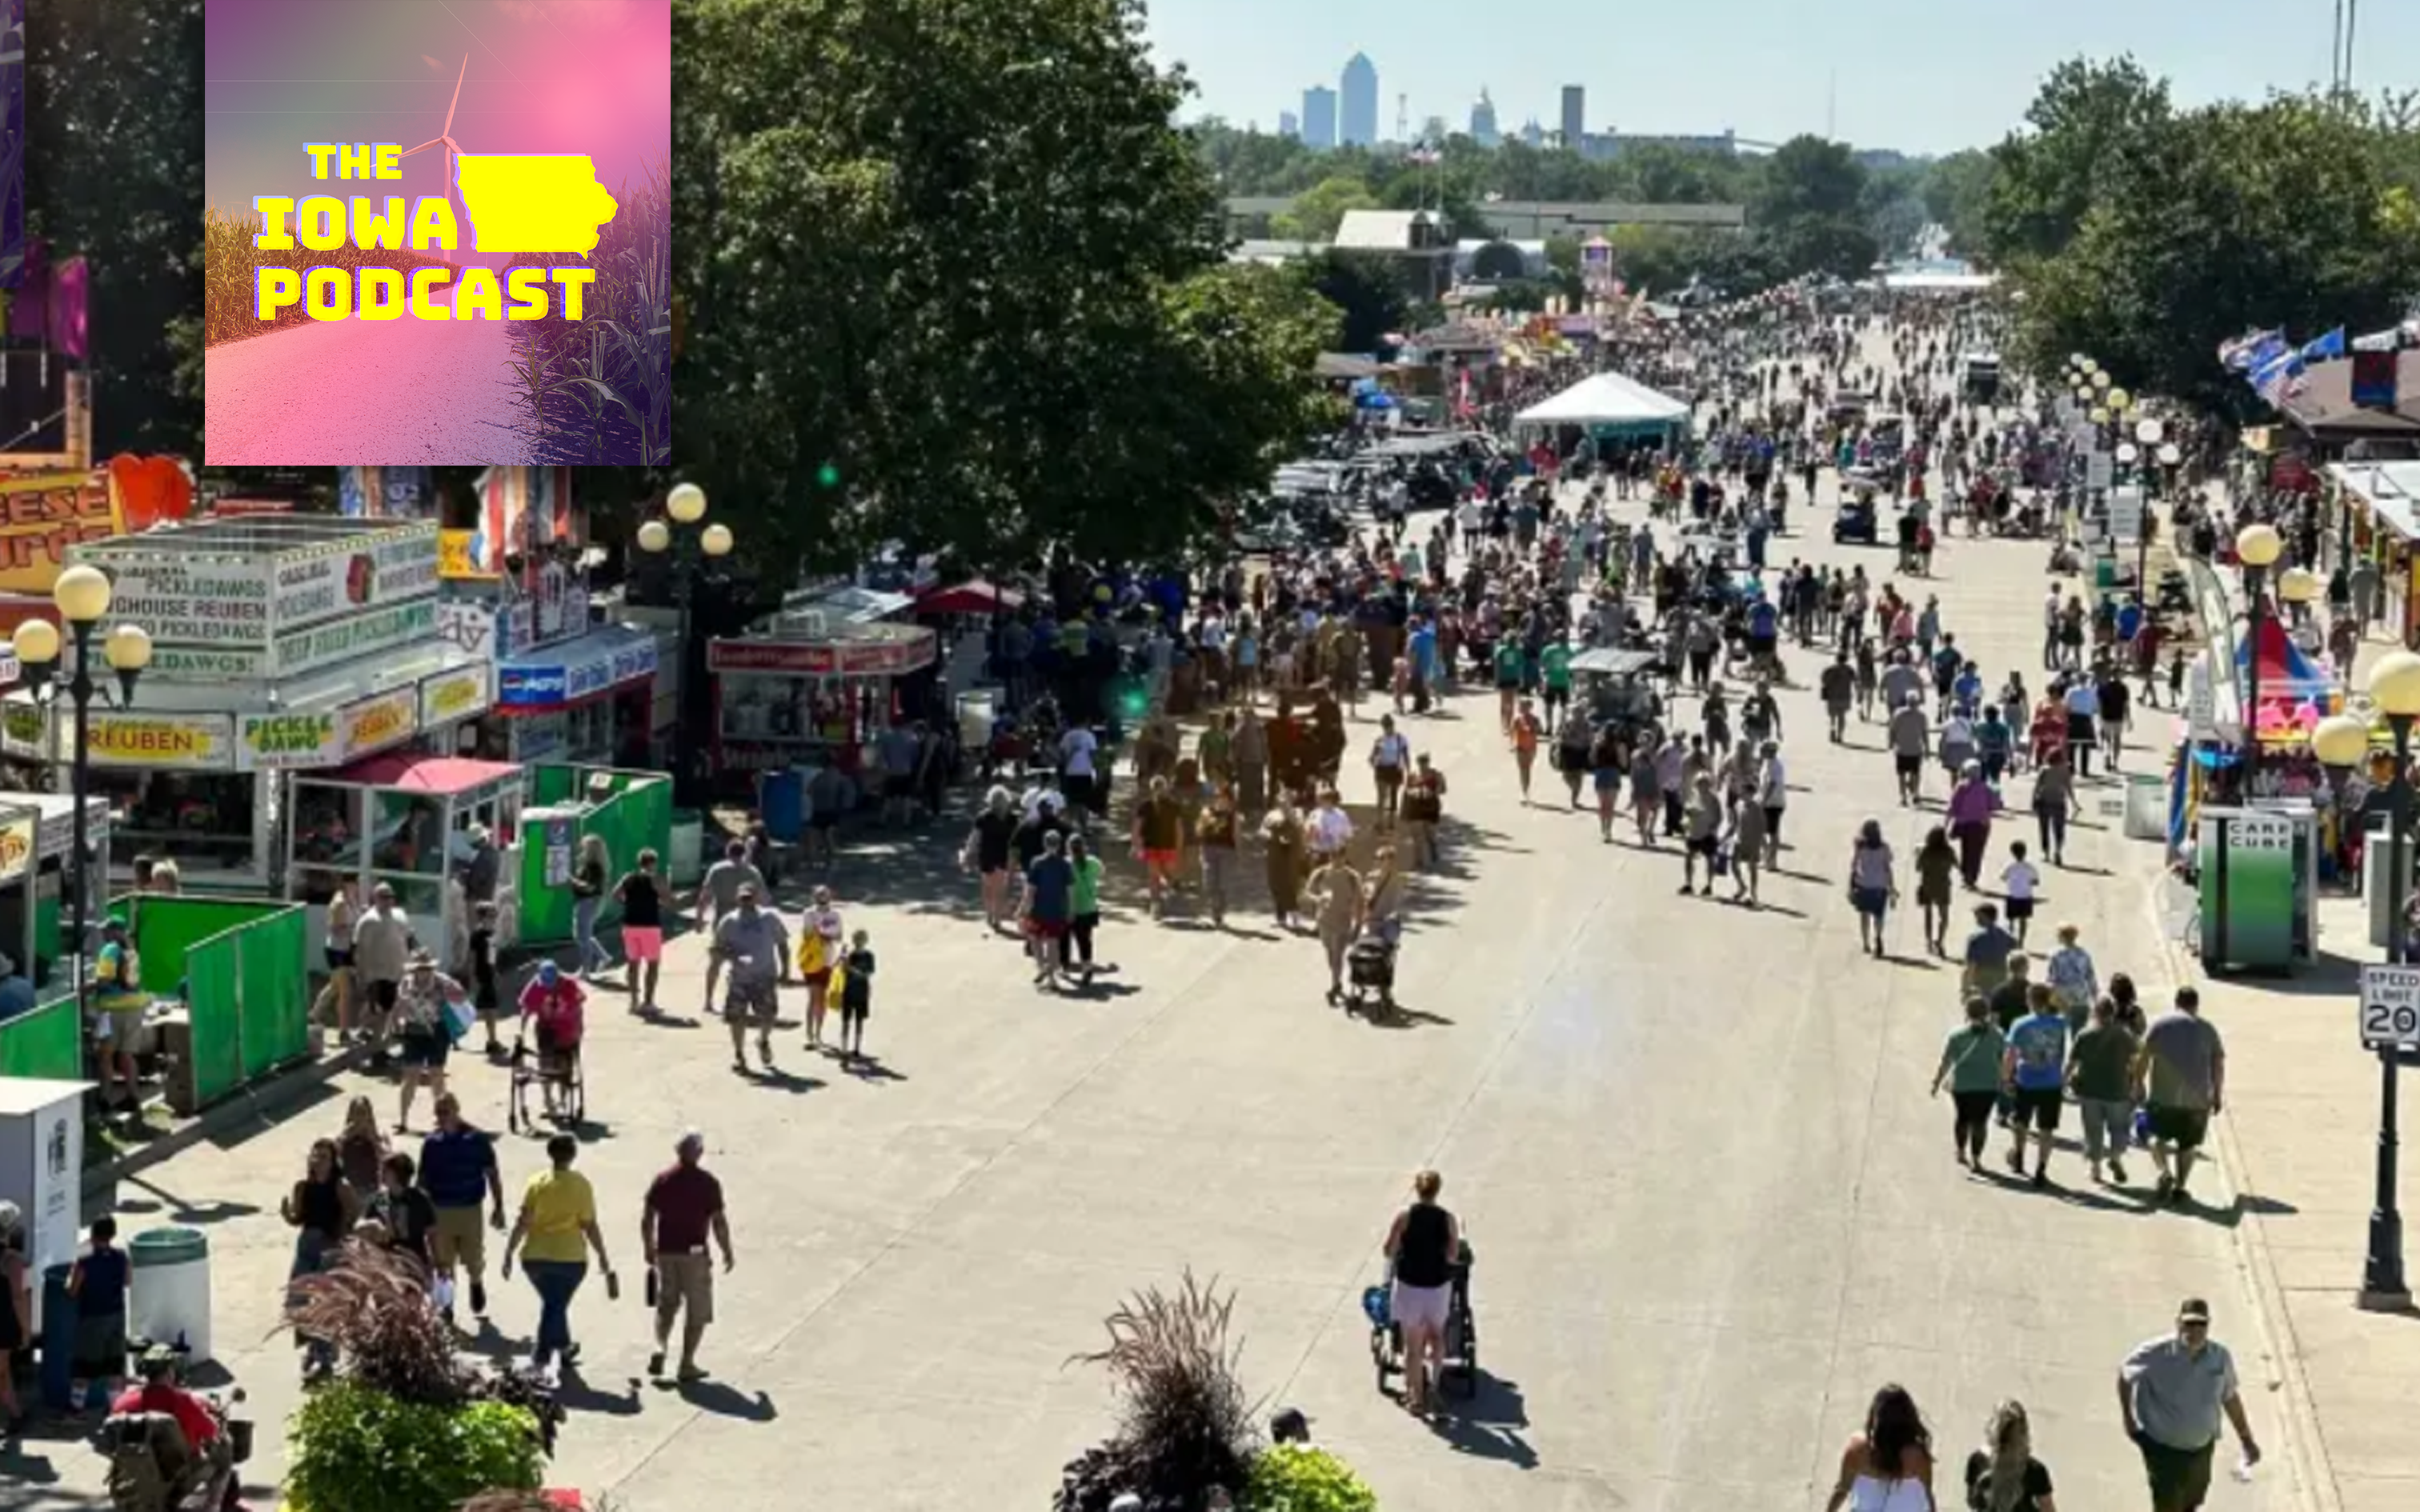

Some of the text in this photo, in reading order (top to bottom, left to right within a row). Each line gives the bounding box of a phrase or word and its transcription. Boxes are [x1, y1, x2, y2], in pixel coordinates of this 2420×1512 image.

[193, 600, 266, 620] REUBEN
[245, 714, 335, 738] PICKLE
[86, 729, 194, 751] REUBEN
[258, 732, 320, 754] DAWG
[2230, 836, 2290, 849] CUBE
[2369, 972, 2419, 986] SPEED
[2371, 989, 2412, 1002] LIMIT
[2366, 1005, 2416, 1033] 20
